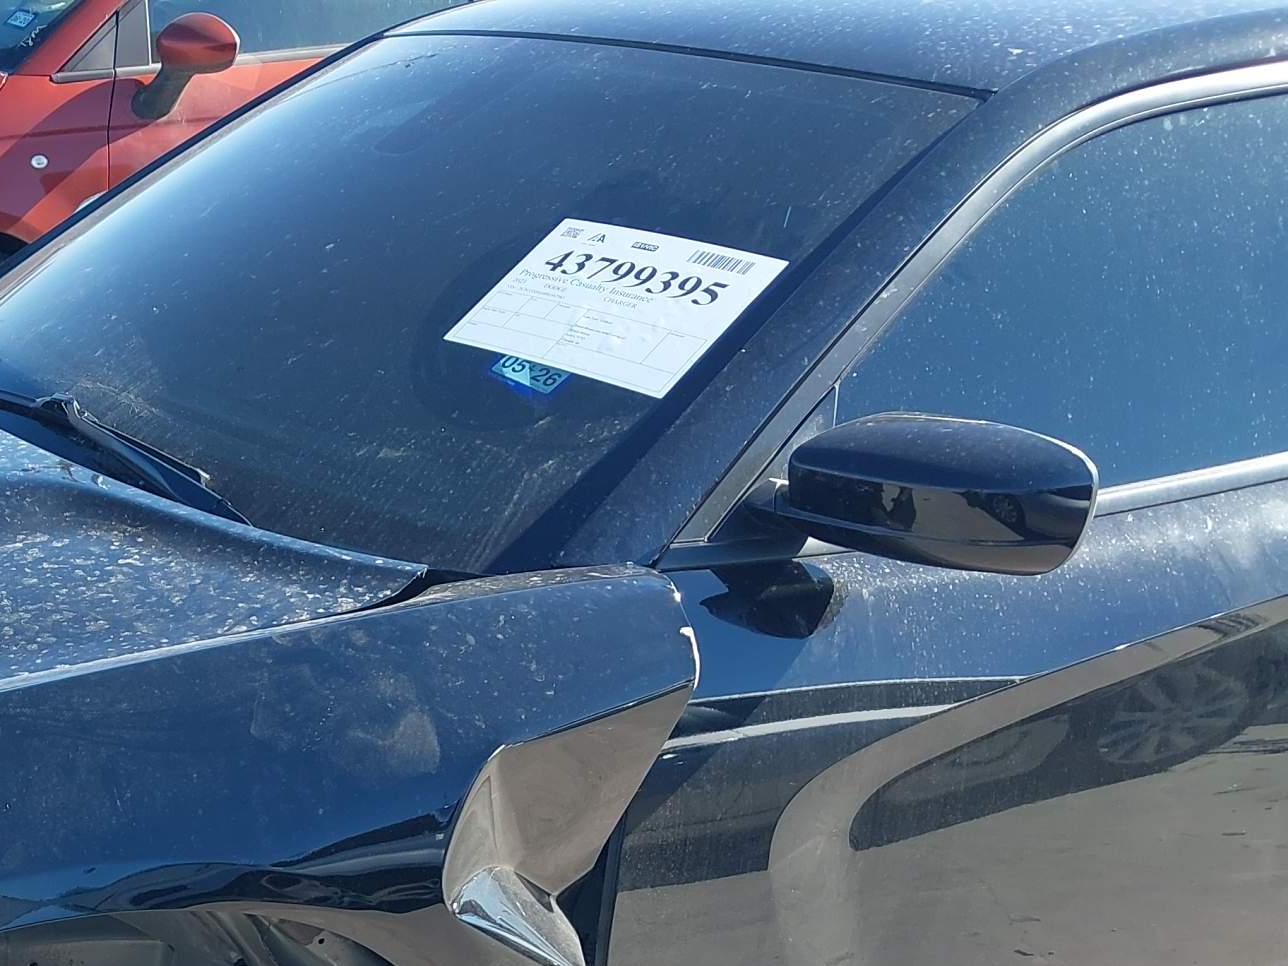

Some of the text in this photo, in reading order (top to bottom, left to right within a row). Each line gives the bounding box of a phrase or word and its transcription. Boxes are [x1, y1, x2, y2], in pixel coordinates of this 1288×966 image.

[518, 269, 570, 285] Progressive
[545, 250, 730, 306] 43799395
[530, 367, 562, 387] 26
